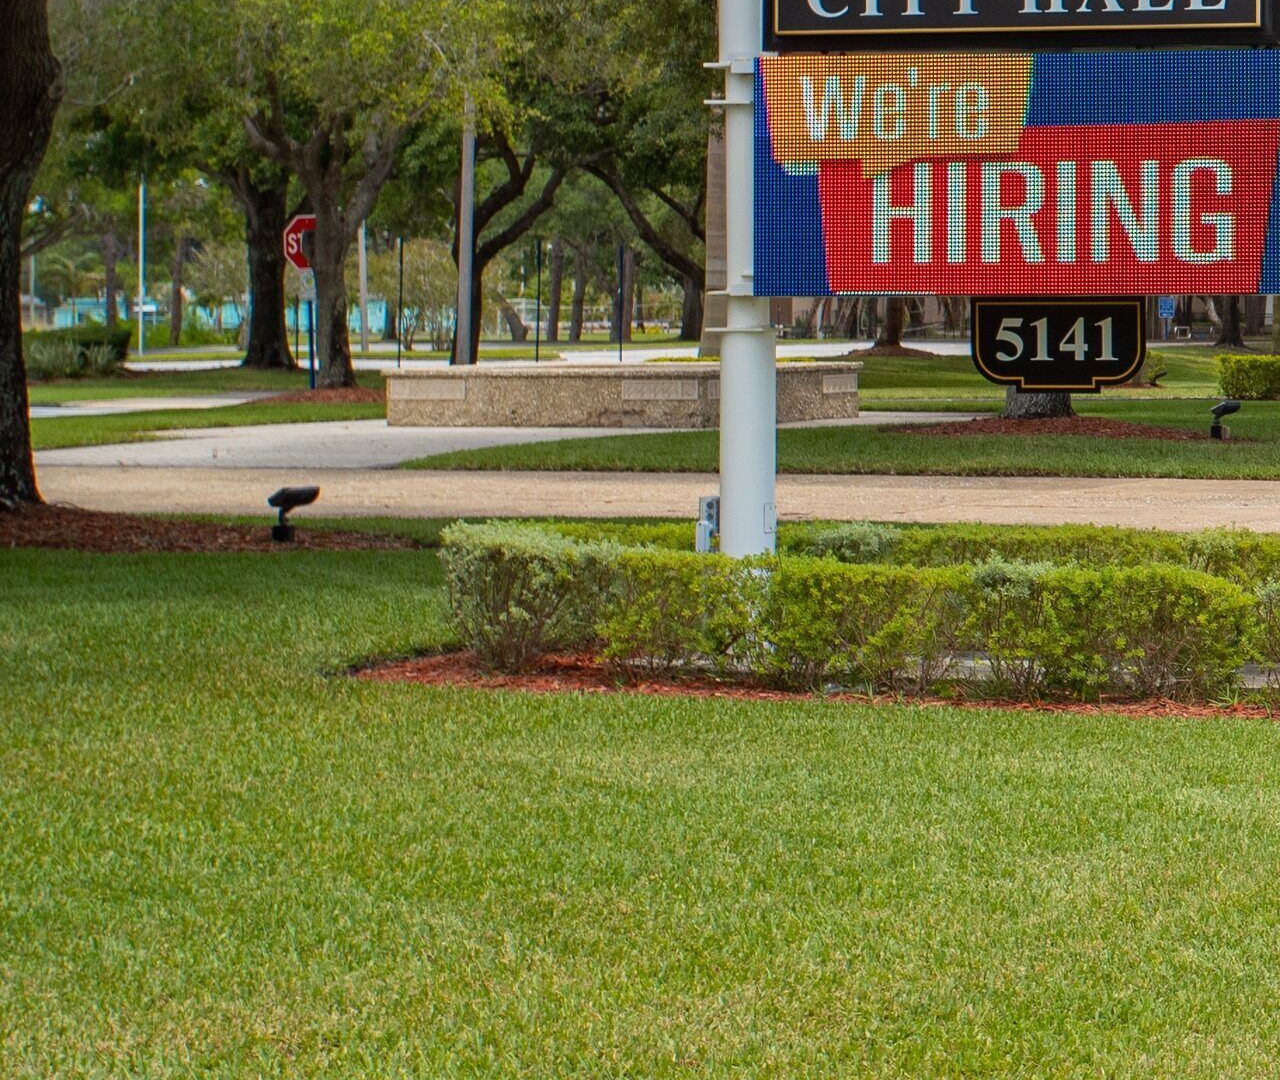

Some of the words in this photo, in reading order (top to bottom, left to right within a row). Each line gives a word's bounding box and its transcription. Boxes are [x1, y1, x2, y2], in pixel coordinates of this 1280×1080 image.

[802, 67, 990, 142] We're
[871, 157, 1238, 266] HIRING
[995, 317, 1120, 362] 5141
